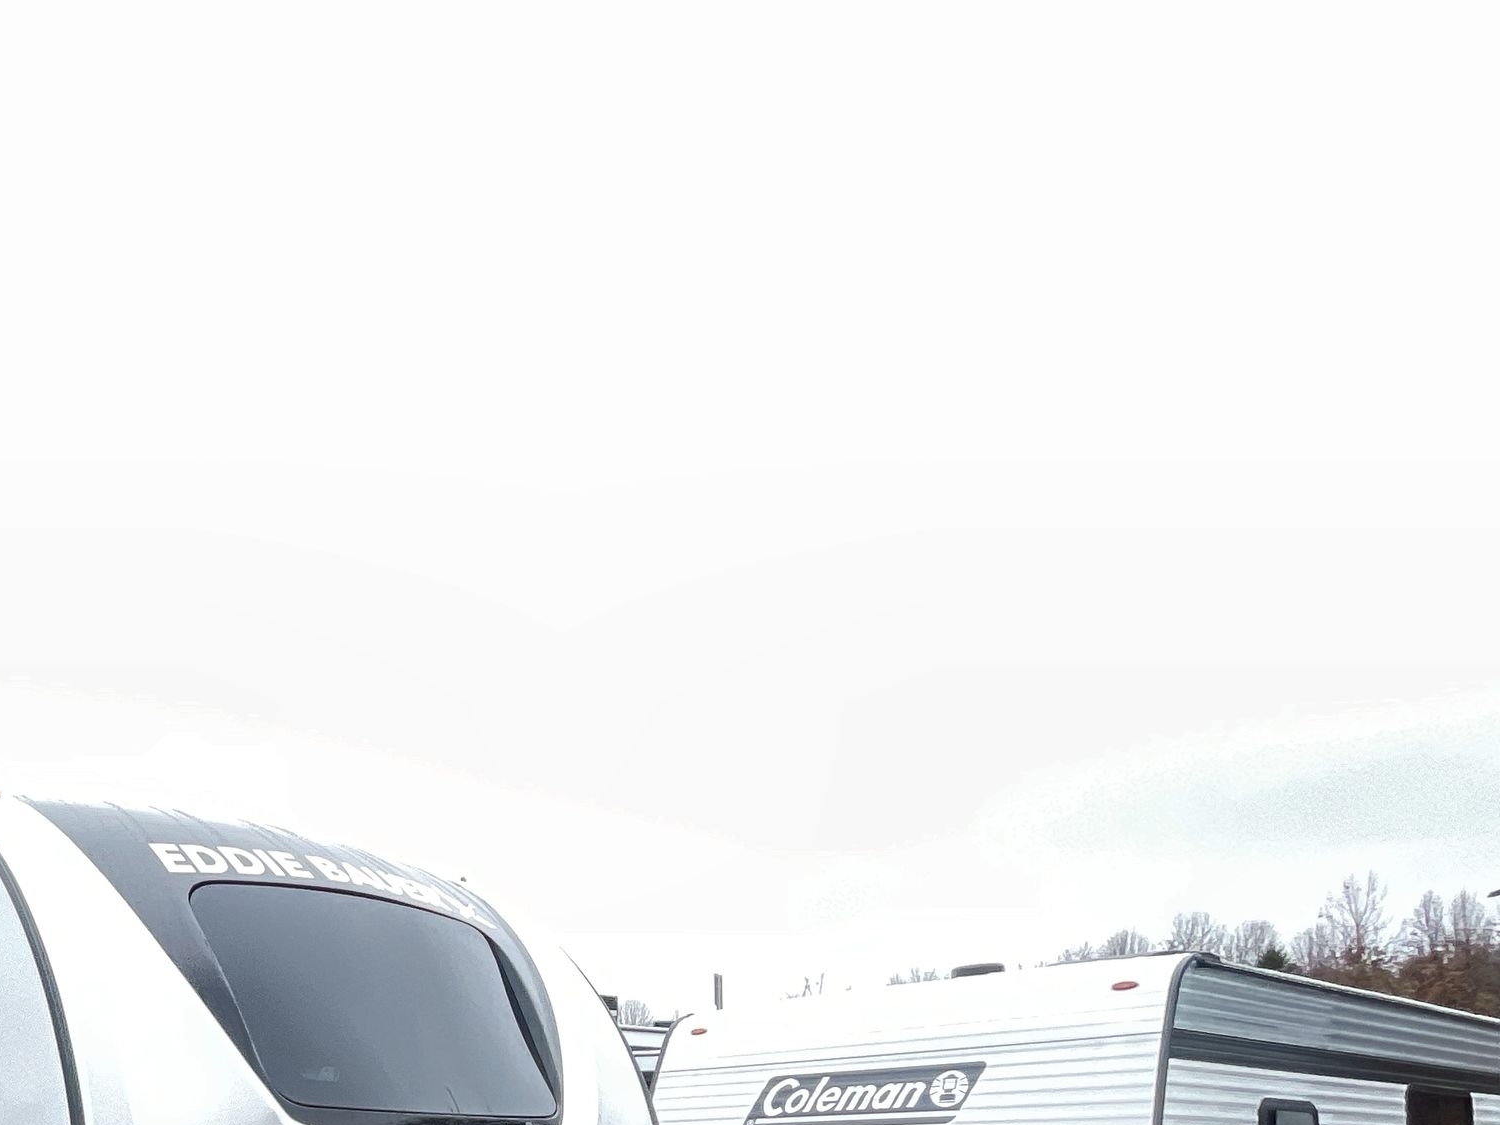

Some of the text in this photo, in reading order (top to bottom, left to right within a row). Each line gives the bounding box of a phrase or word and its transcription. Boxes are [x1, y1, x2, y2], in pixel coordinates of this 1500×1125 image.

[148, 842, 315, 879] EDDIE
[304, 854, 454, 911] BAUER
[762, 1075, 927, 1117] Coleman
